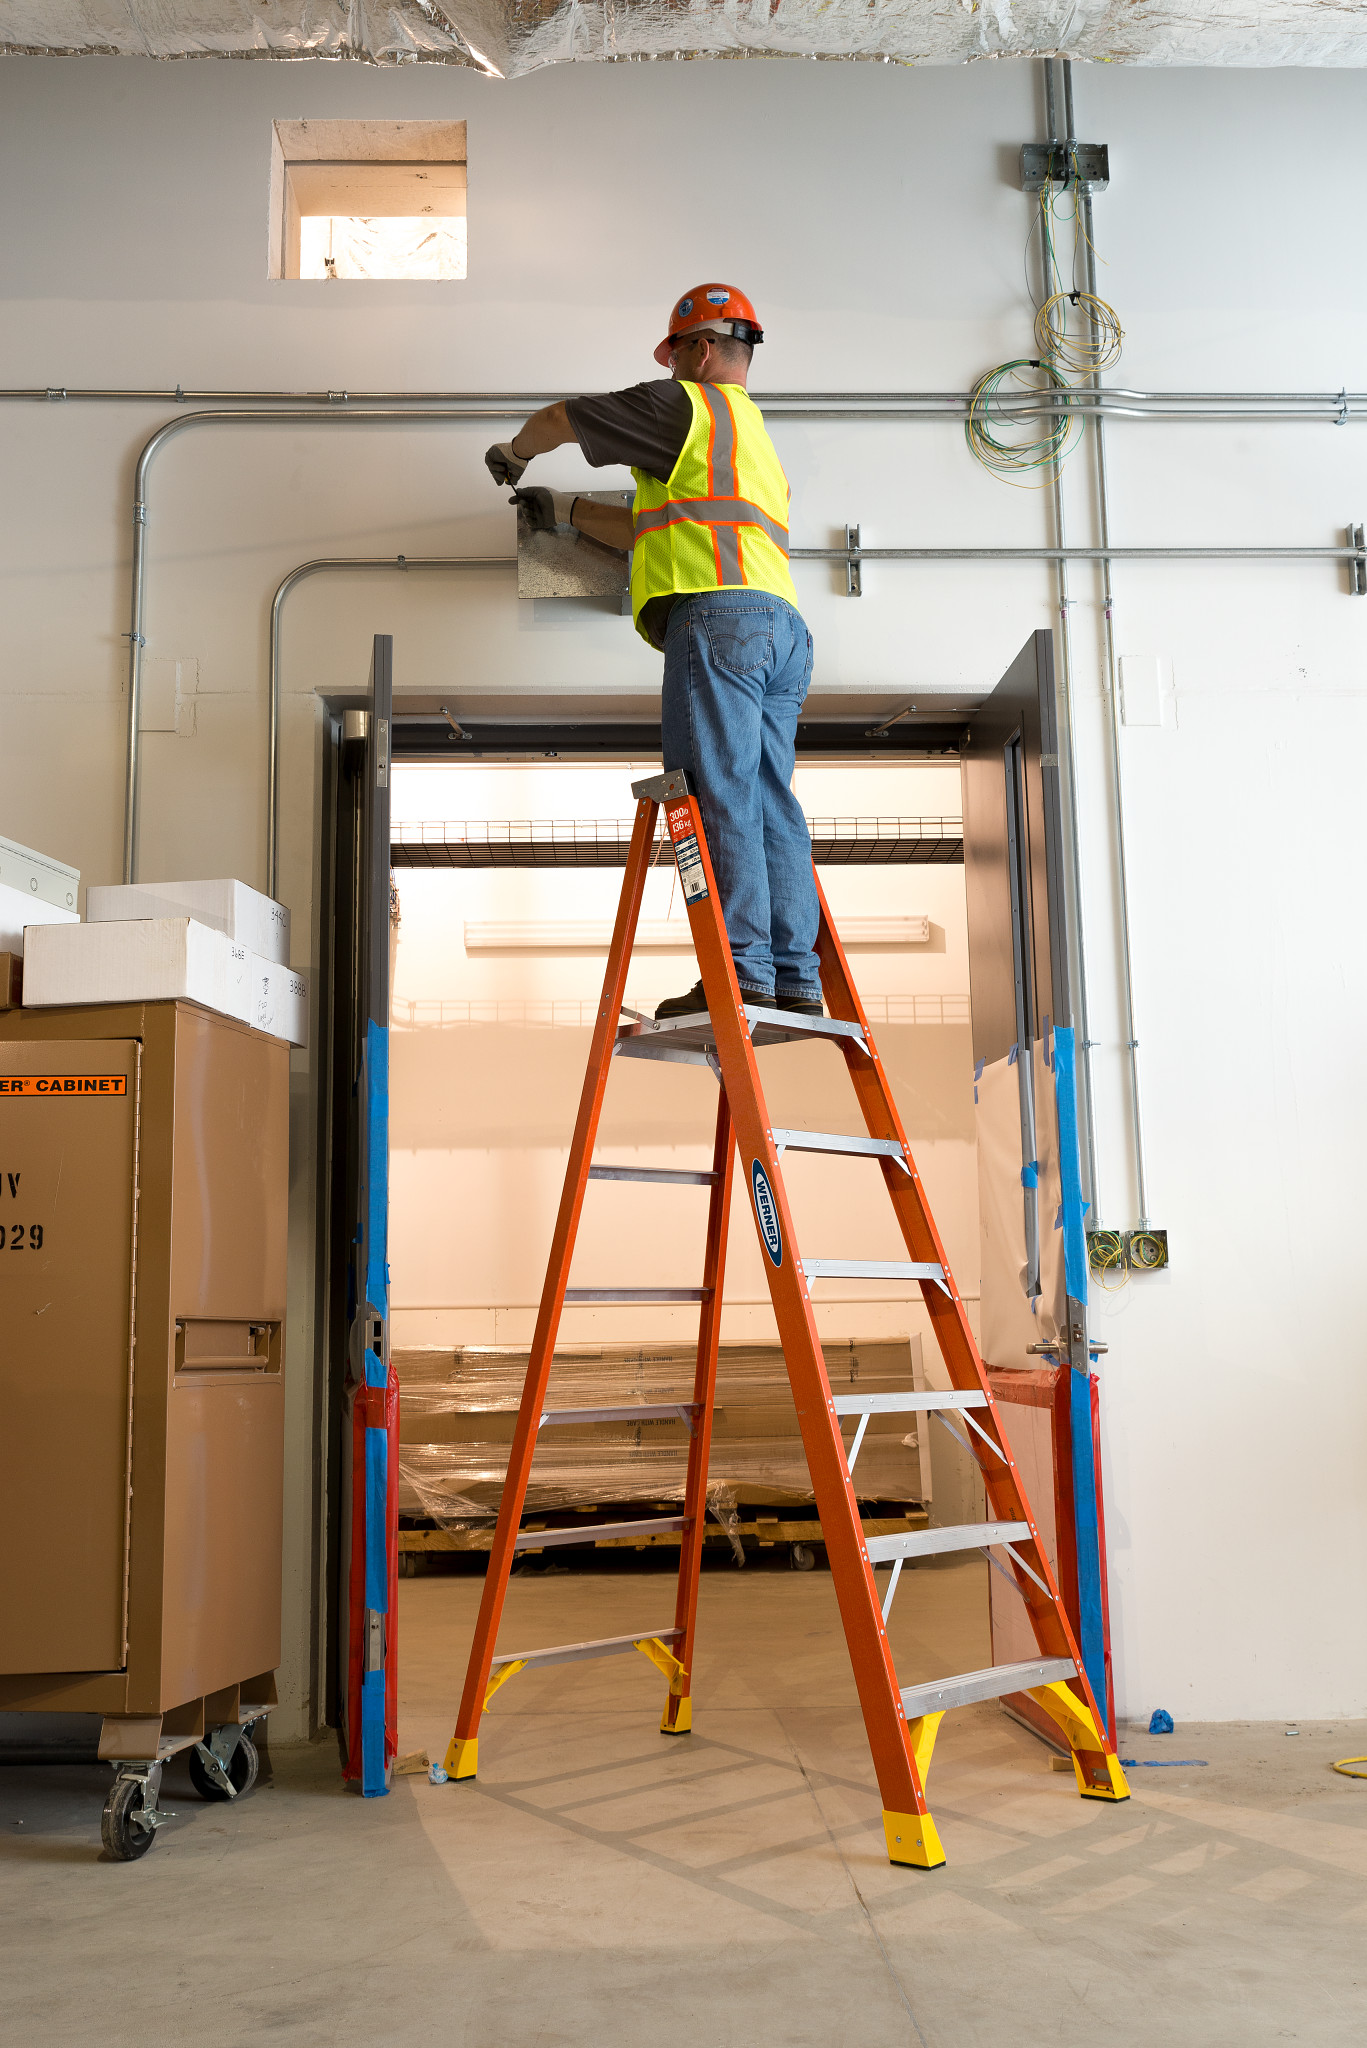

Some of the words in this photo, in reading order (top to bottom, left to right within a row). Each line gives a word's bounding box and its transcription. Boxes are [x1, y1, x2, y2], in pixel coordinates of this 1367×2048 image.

[35, 1079, 123, 1092] CABINET
[0, 1173, 21, 1198] V
[756, 1180, 778, 1246] WERNER
[655, 1418, 676, 1426] HANDLE
